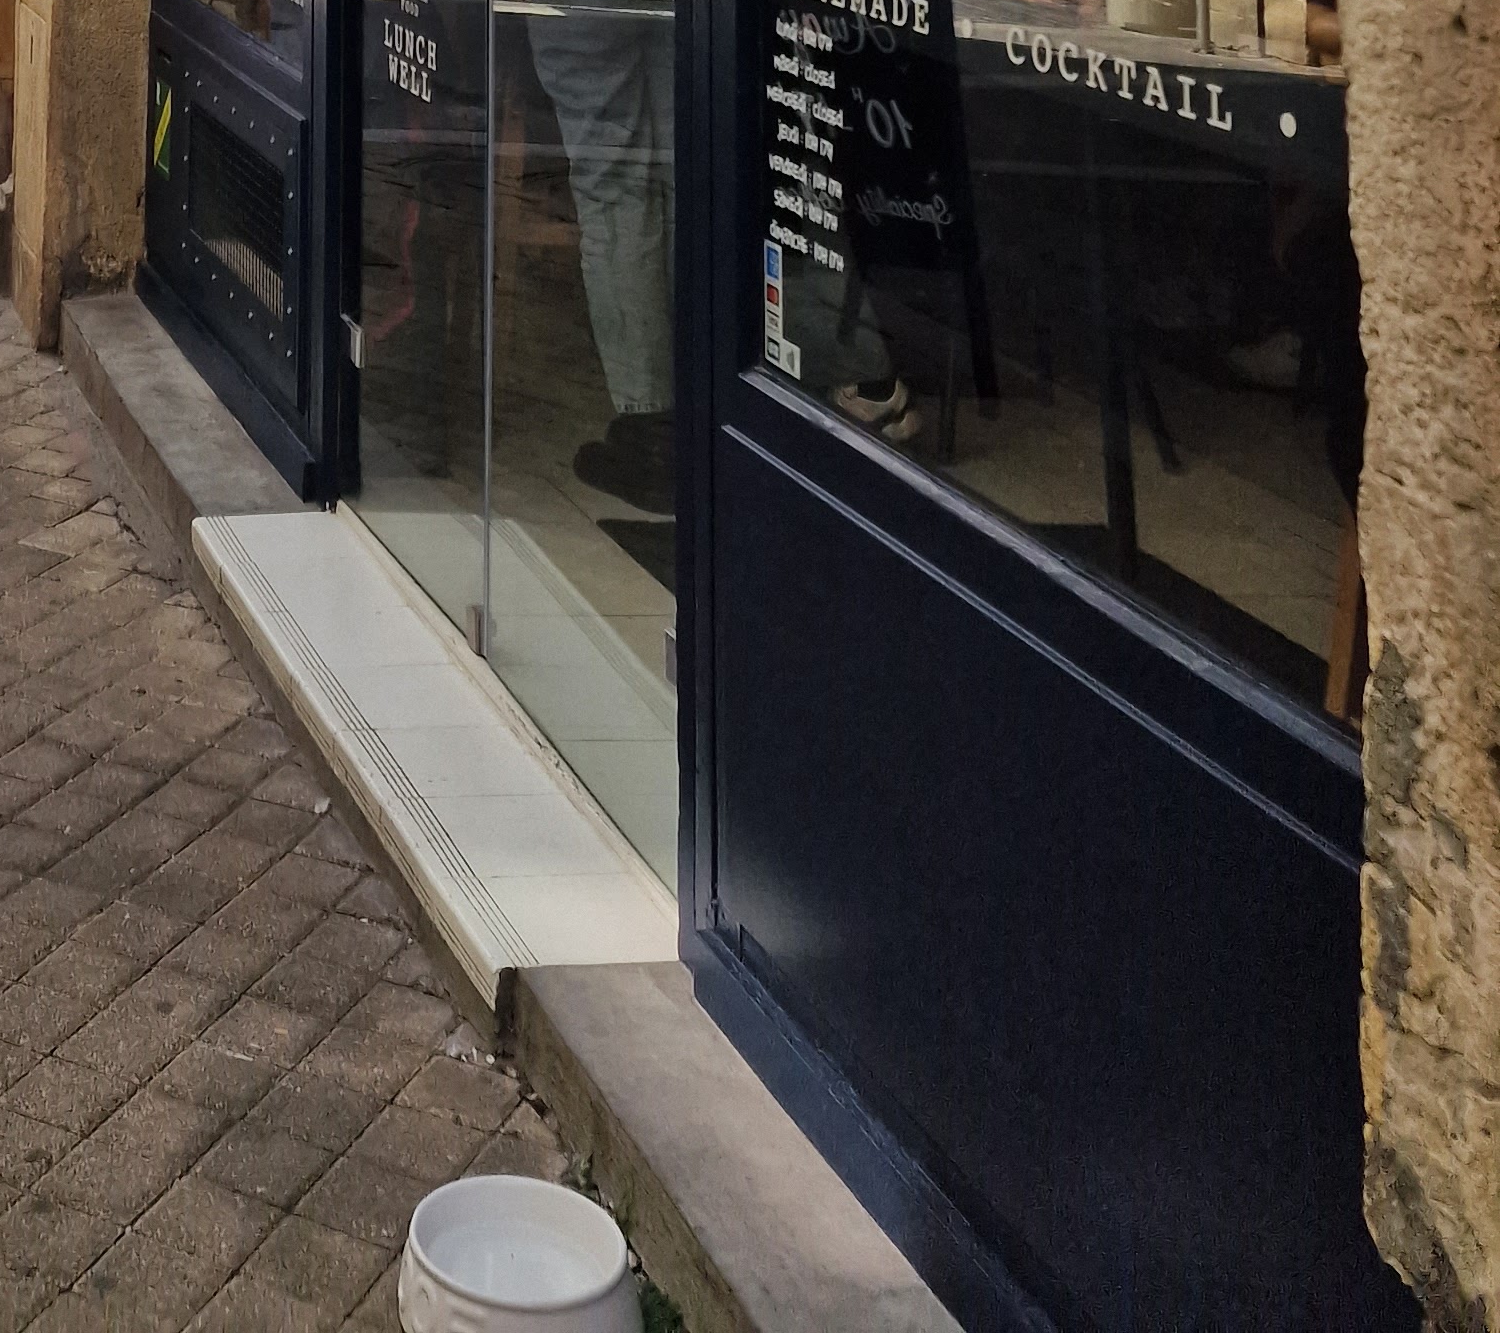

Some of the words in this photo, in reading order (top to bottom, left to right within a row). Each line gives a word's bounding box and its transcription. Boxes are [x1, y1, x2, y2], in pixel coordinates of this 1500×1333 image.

[383, 17, 437, 72] LUNCH
[388, 53, 432, 104] WELL
[1005, 27, 1233, 132] COCKTAIL
